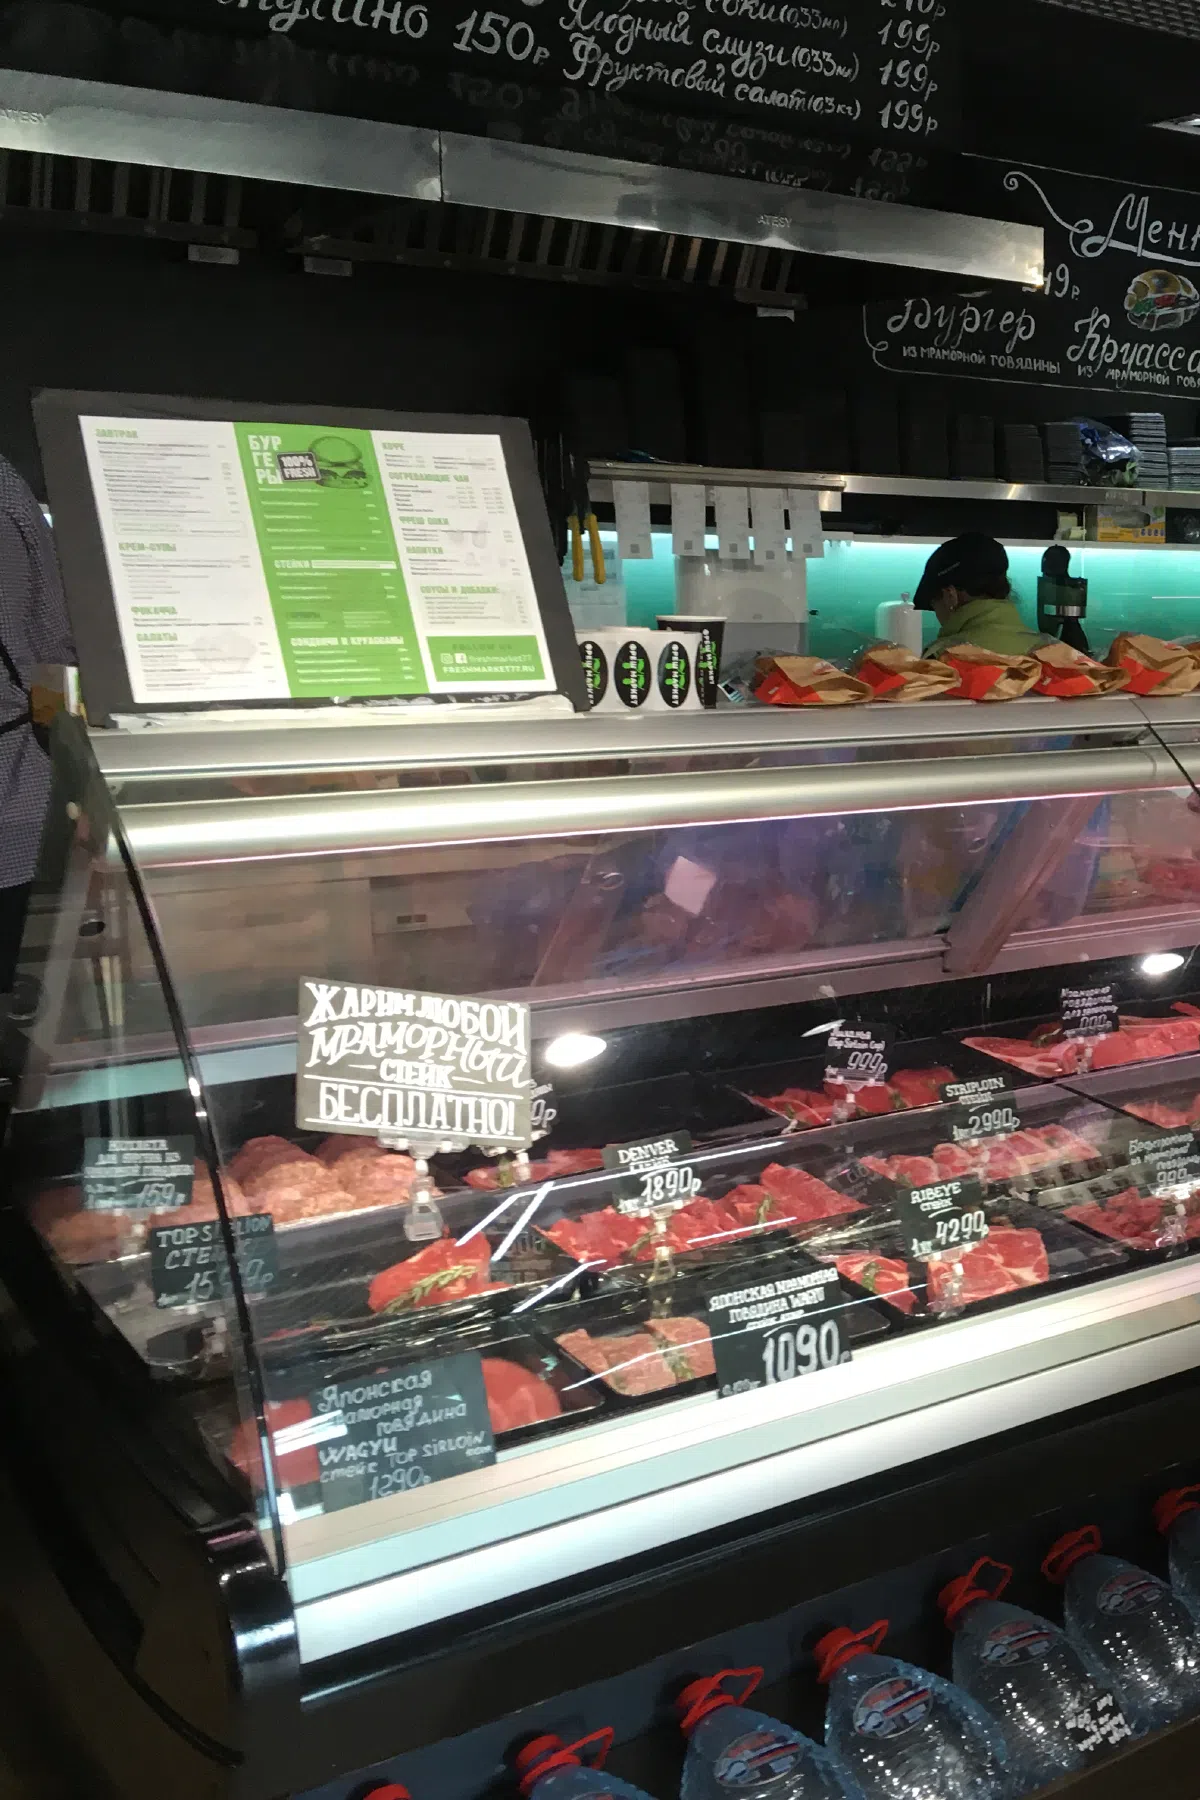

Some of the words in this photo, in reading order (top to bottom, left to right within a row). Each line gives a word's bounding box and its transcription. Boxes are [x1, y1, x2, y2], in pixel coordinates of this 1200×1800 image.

[248, 434, 282, 451] БУР
[252, 451, 274, 467] ГЕ
[255, 468, 283, 484] РЫ
[305, 1021, 531, 1088] МРАМОРНЫЙ
[319, 1082, 516, 1136] БЕСПЛАТНО!
[617, 1139, 680, 1164] DENVER
[911, 1182, 962, 1204] RIBEYE
